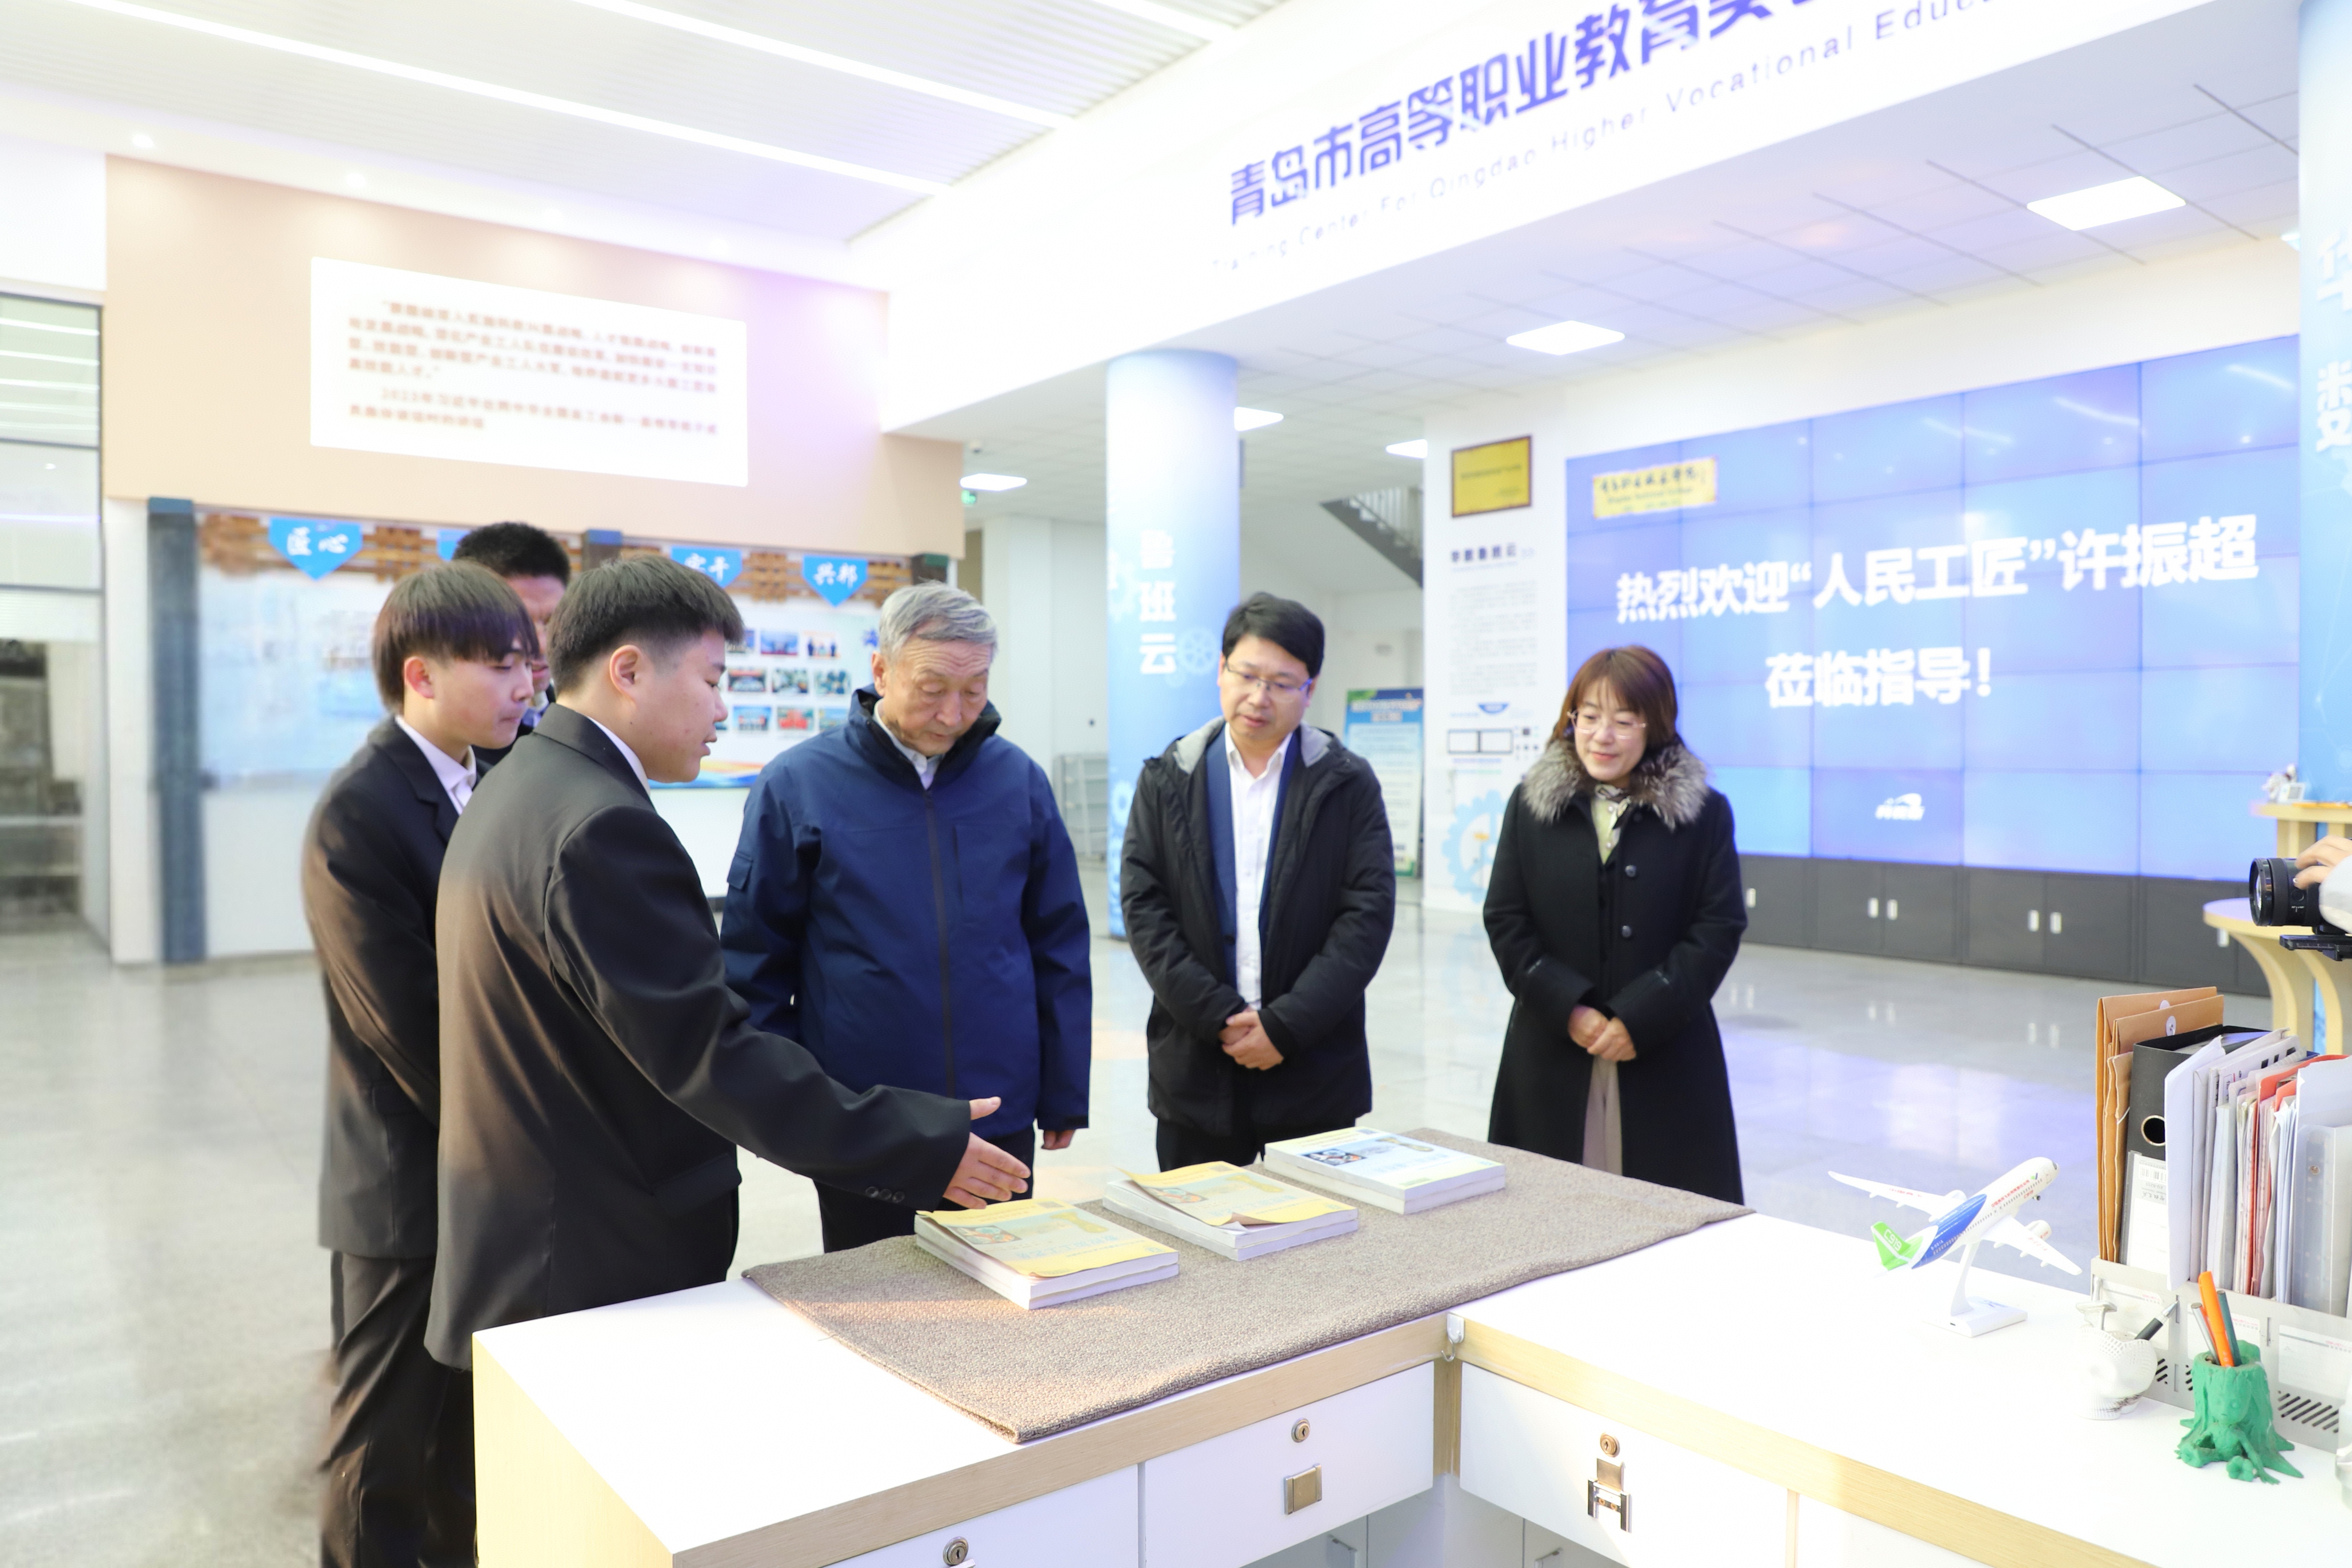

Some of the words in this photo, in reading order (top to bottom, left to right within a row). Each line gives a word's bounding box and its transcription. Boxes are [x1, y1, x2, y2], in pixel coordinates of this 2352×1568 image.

[1230, 0, 1809, 226] 青岛市高等职业教育
[1299, 209, 1368, 246] Center
[1380, 191, 1417, 212] For
[1429, 150, 1536, 198] Qingdao
[1551, 106, 1648, 151] Higher
[1665, 24, 1854, 113] Vocational
[1875, 0, 1989, 40] Educ
[286, 527, 349, 556] 匠心
[813, 562, 859, 590] 兴邦
[1616, 513, 2259, 624] 热烈欢迎“人民工匠”许振超
[1883, 1228, 1902, 1251] C919
